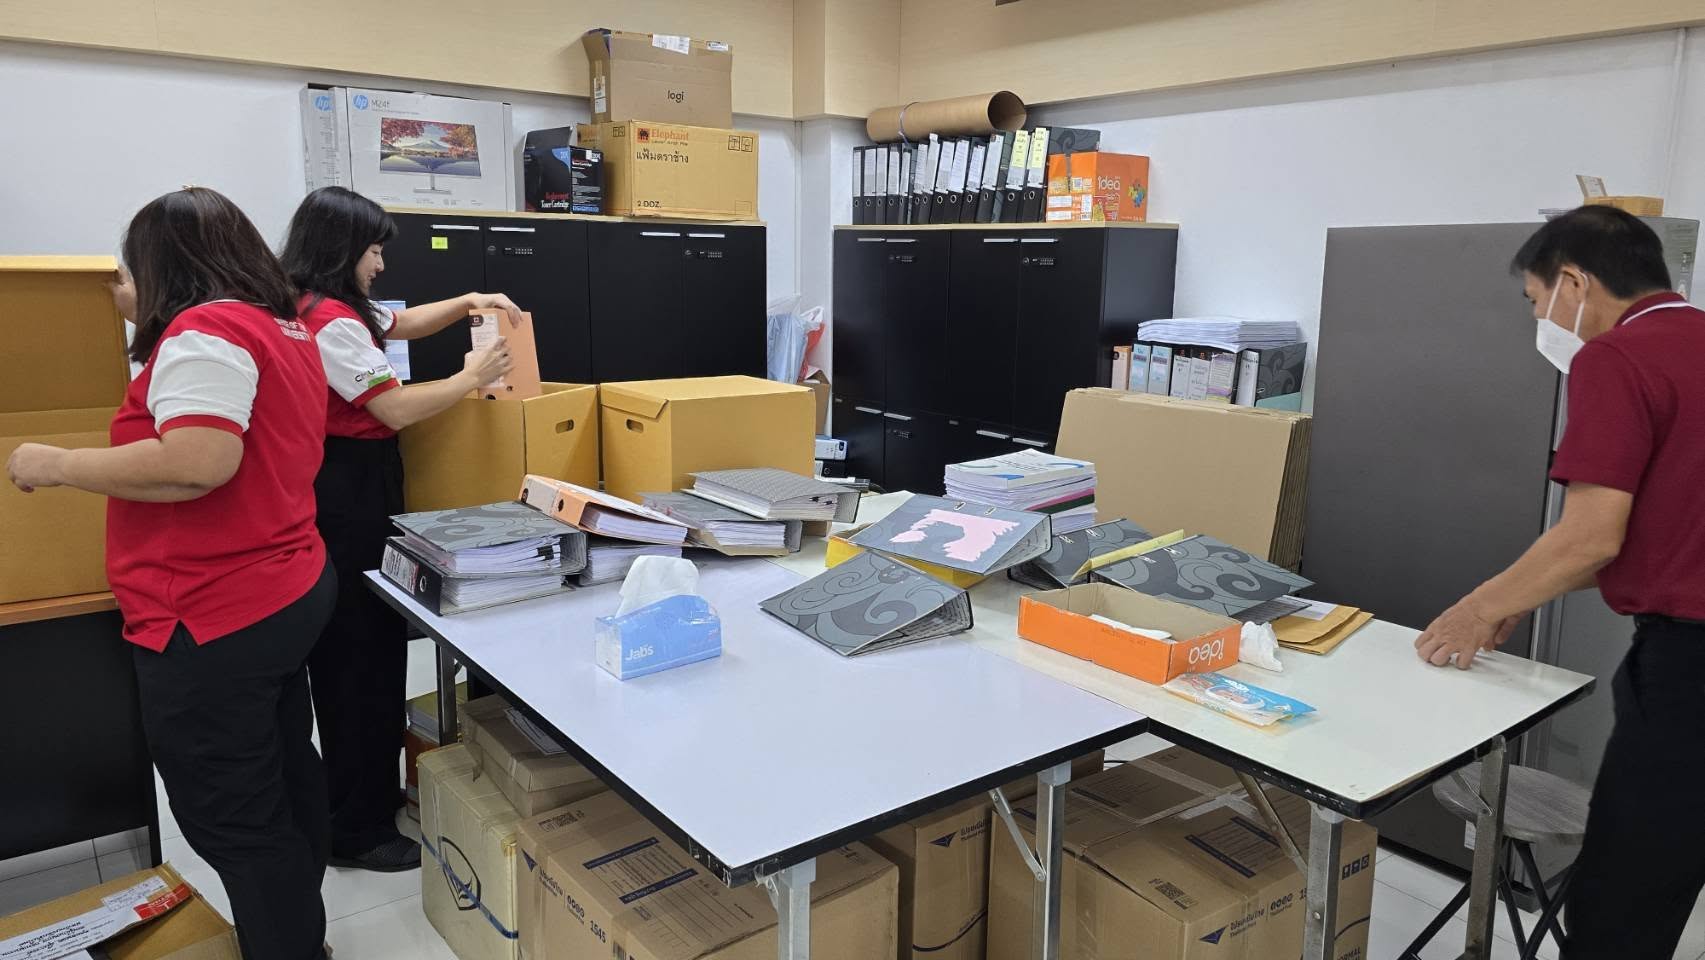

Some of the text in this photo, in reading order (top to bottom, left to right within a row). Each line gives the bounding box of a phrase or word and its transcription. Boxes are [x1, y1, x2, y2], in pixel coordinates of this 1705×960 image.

[667, 90, 685, 104] logi
[651, 128, 689, 141] Elephant
[636, 148, 689, 163] แฟ้มตราช้าง
[1098, 176, 1120, 190] idea
[1188, 637, 1225, 665] idea
[590, 920, 607, 943] 1545
